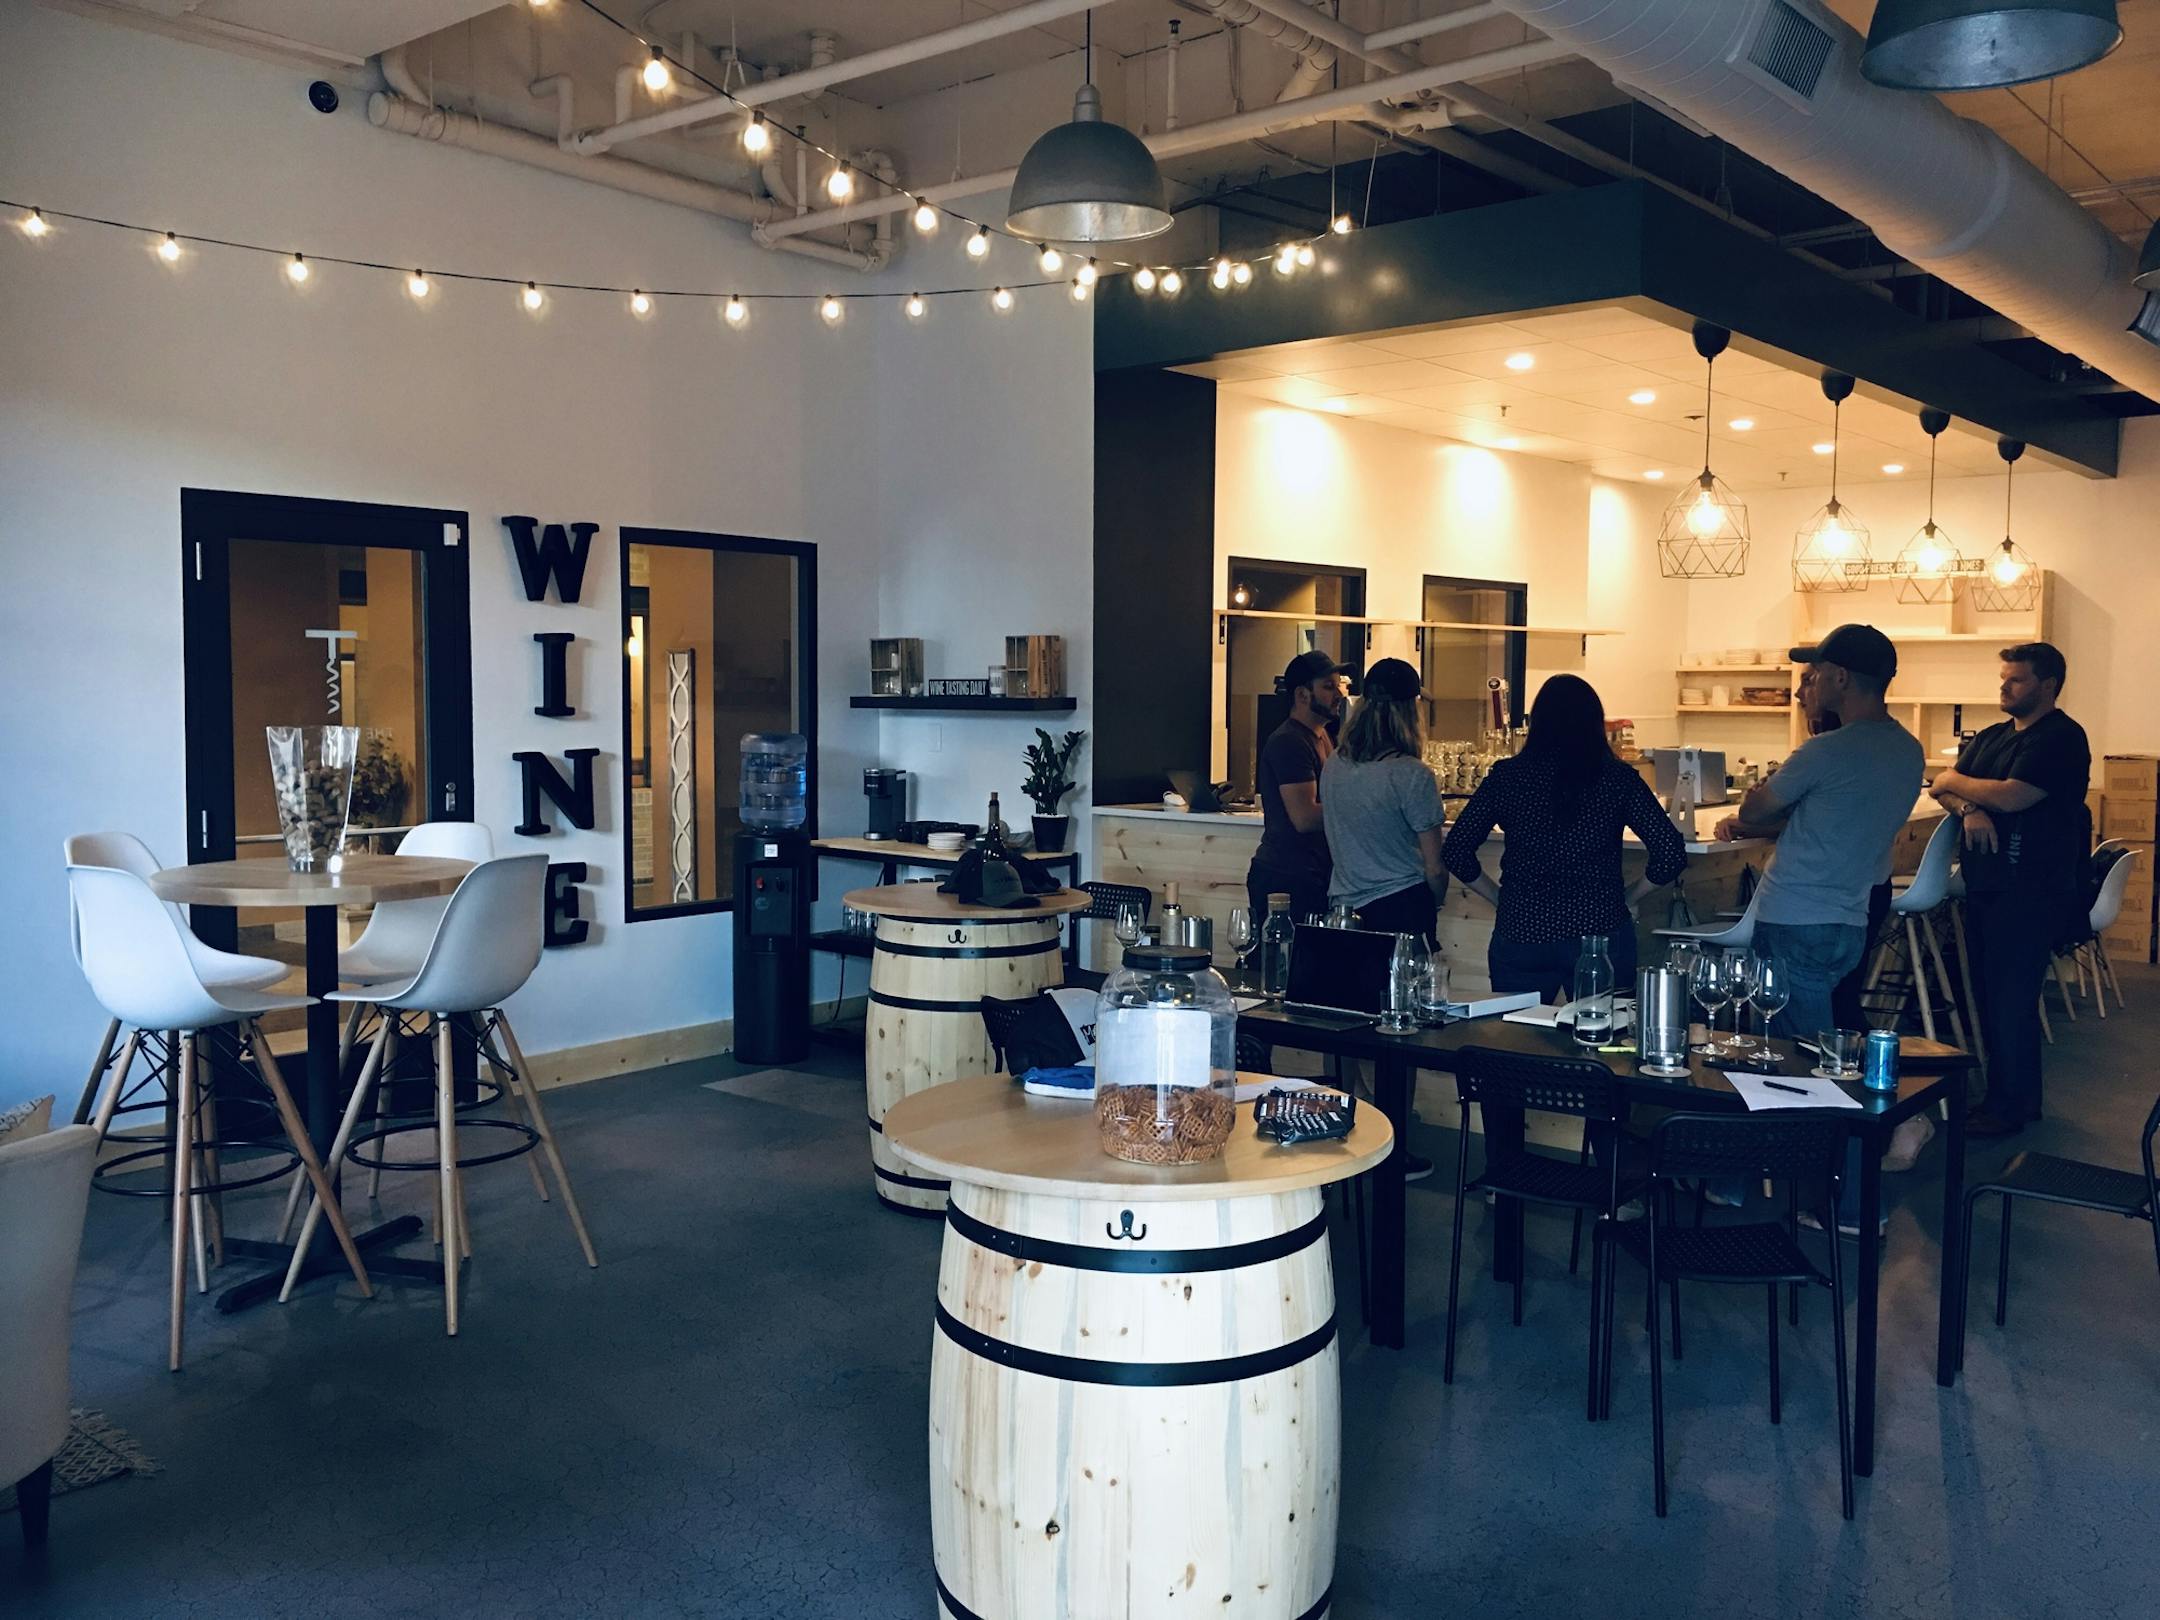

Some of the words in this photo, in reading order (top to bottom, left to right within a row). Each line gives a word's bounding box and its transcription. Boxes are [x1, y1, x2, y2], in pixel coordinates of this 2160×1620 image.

[501, 515, 600, 948] WINE
[929, 680, 945, 696] WINE
[945, 680, 969, 696] TASTING
[970, 680, 987, 696] DAILY
